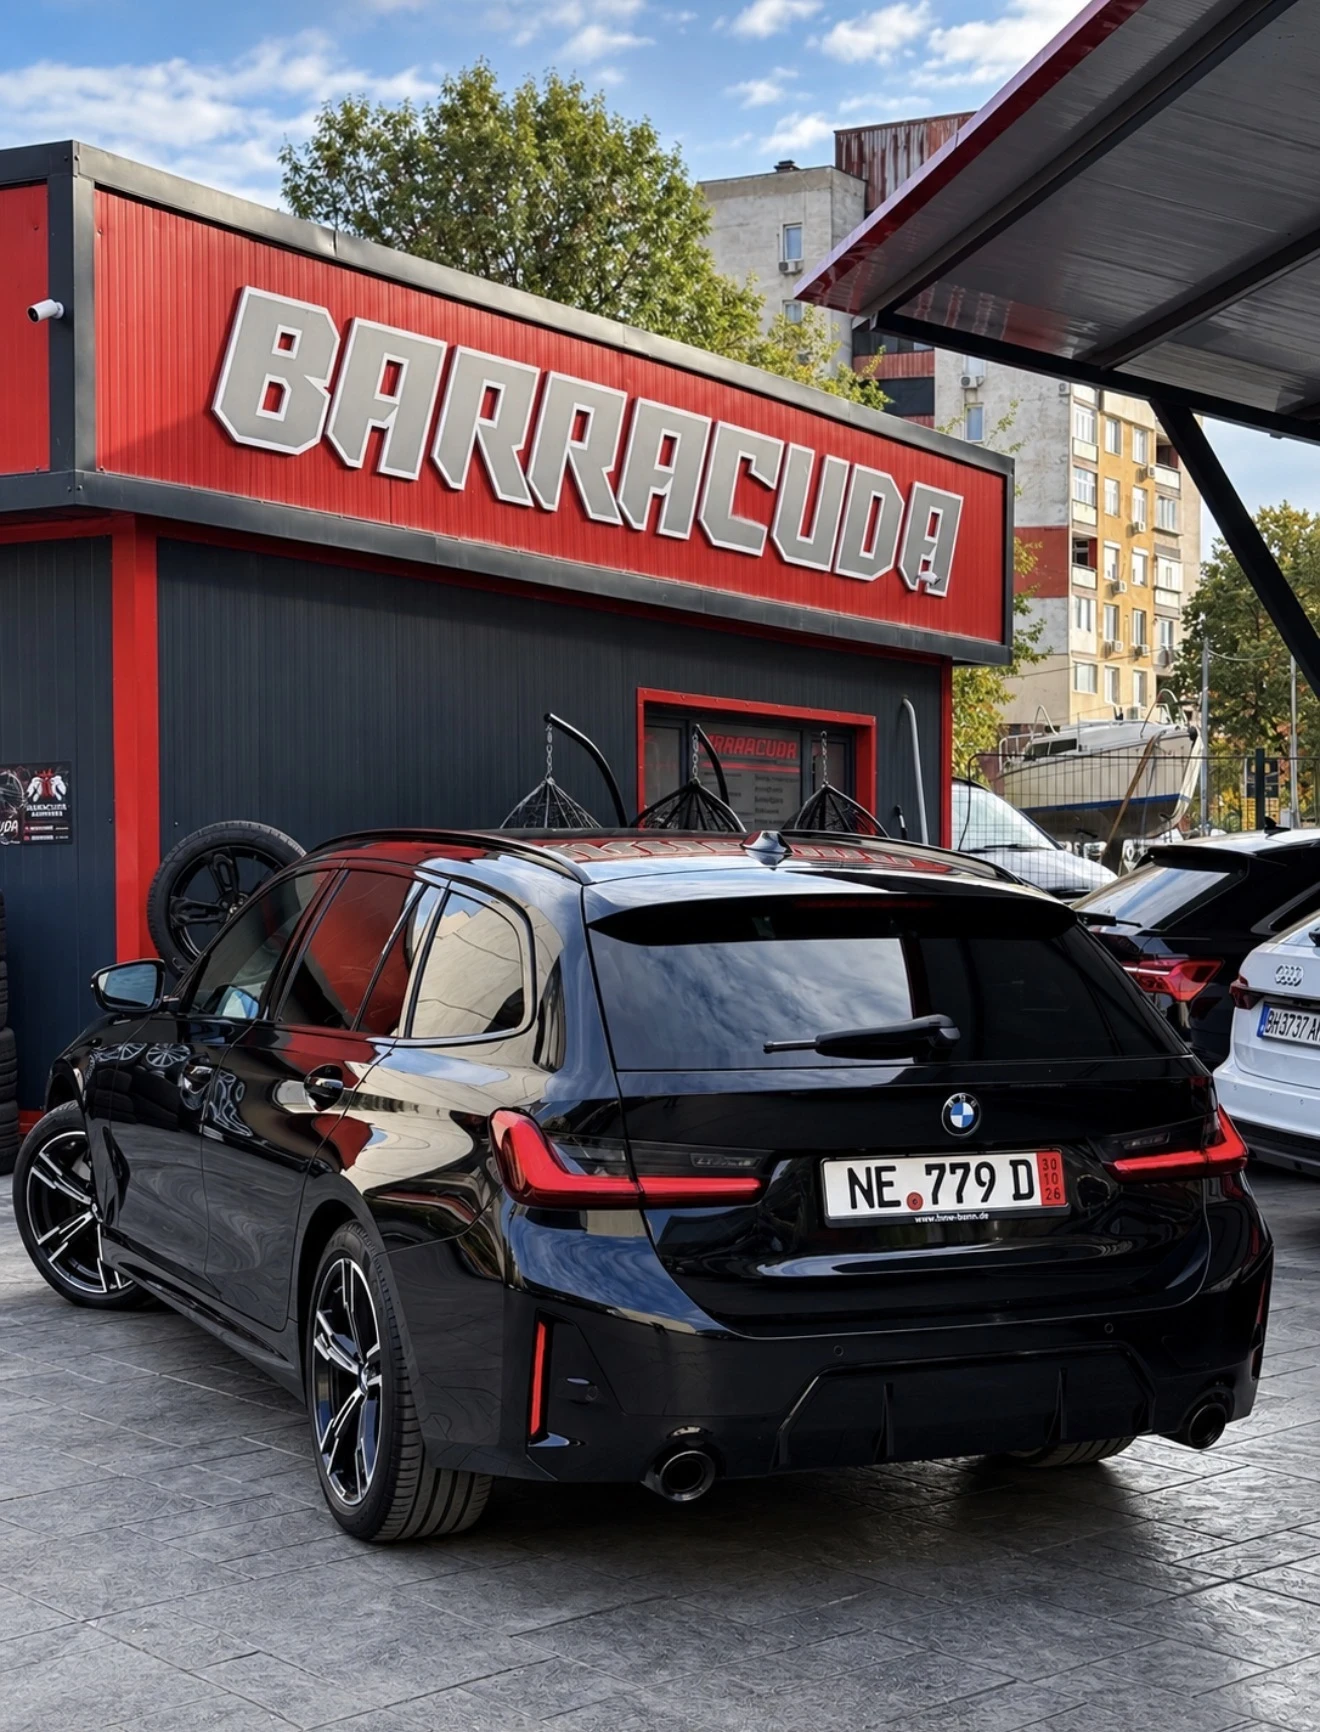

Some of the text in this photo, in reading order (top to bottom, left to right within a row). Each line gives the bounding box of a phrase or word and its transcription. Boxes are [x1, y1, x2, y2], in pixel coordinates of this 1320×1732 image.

[212, 285, 964, 597] BARRACUDA
[1279, 1013, 1310, 1039] 3737
[1042, 1157, 1057, 1171] 30
[847, 1158, 1035, 1210] NE 779 D
[1043, 1172, 1059, 1185] 10
[1045, 1187, 1061, 1201] 26
